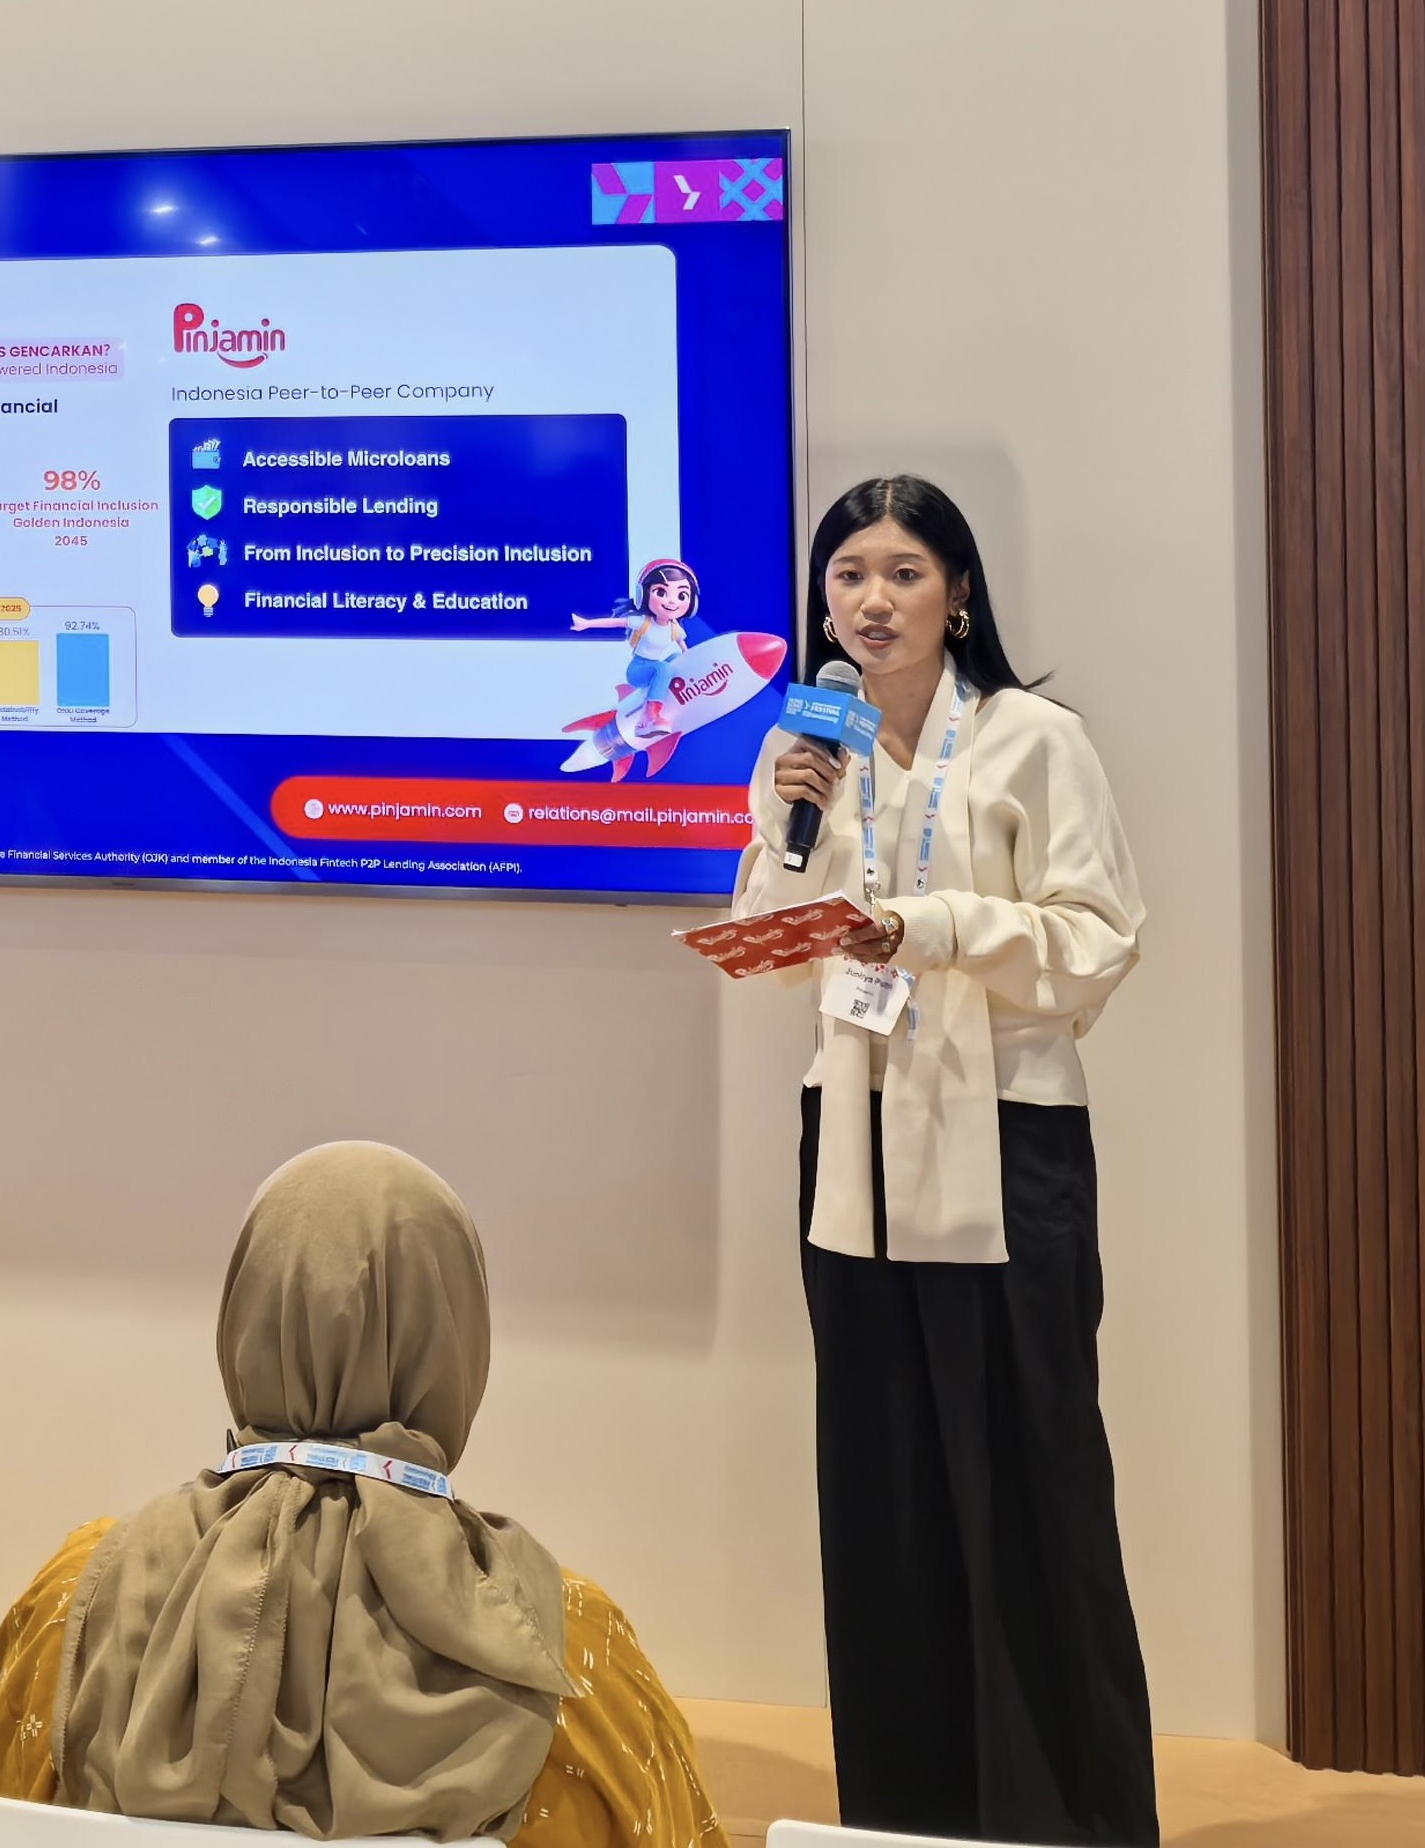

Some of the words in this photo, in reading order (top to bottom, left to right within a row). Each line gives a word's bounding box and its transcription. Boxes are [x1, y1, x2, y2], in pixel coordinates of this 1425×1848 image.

[173, 303, 286, 354] Pinjamin
[9, 344, 111, 358] GENCARKAN?
[46, 361, 119, 376] Indonesia
[172, 386, 262, 401] Indonesia
[268, 385, 392, 400] Peer-to-Peer
[397, 383, 494, 403] Company
[243, 451, 342, 467] Accessible
[348, 451, 450, 467] Microloans
[43, 470, 101, 491] 98%
[33, 500, 94, 512] Financial
[97, 499, 159, 511] Inclusion
[243, 498, 357, 516] Responsible
[362, 498, 439, 517] Lending
[13, 517, 60, 528] Golden
[63, 517, 130, 528] Indonesia
[55, 536, 88, 546] 2045
[244, 546, 291, 562] From
[296, 545, 380, 562] Inclusion
[385, 547, 405, 562] to
[411, 545, 499, 562] Precision
[504, 545, 592, 562] Inclusion
[245, 592, 327, 609] Financial
[333, 593, 407, 613] Literacy
[413, 594, 427, 609] &
[433, 593, 528, 610] Education
[64, 621, 100, 631] 92.74%
[668, 662, 733, 705] Pinjamin
[328, 802, 482, 820] www.pinjamin.com
[529, 806, 755, 828] relations@mail.pinjamin.co
[8, 849, 51, 860] Financial
[53, 850, 92, 861] Services
[94, 851, 141, 864] Authority
[142, 852, 168, 864] (OJK)
[170, 853, 189, 864] and
[192, 854, 234, 865] member
[237, 854, 248, 865] of
[249, 855, 266, 866] the
[269, 856, 317, 867] Indonesia
[320, 856, 358, 868] Fintech
[360, 858, 380, 868] P2P
[383, 858, 425, 871] Lending
[428, 860, 486, 872] Association
[489, 861, 522, 874] (AFPI).
